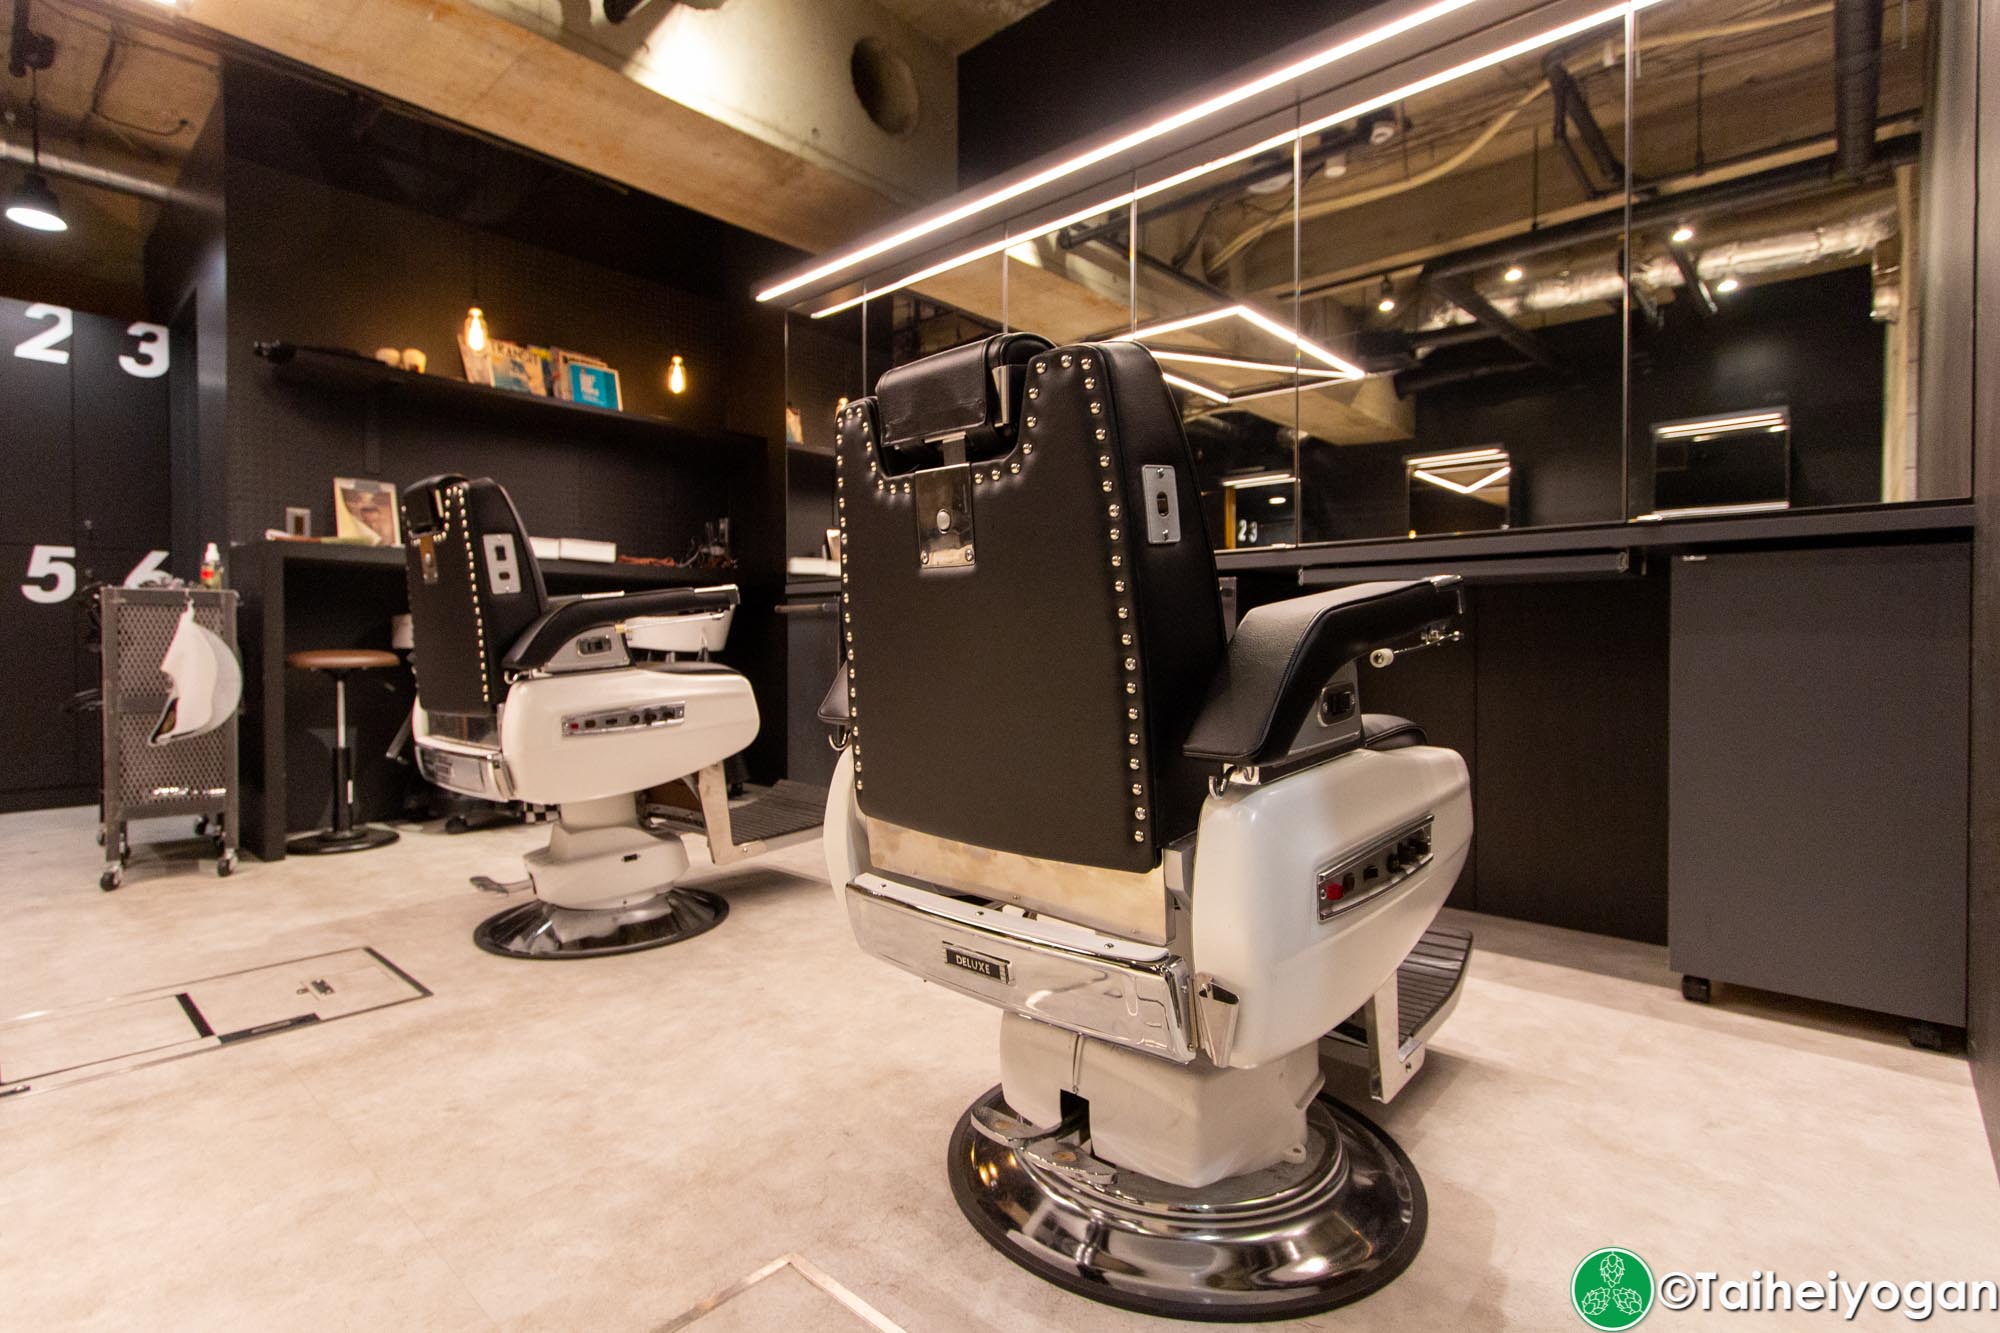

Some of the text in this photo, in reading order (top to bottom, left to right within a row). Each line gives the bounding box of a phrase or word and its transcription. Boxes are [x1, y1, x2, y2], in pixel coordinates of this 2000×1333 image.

[14, 303, 73, 364] 2
[119, 322, 170, 378] 3
[1237, 518, 1248, 542] 2
[22, 546, 76, 604] 5
[955, 954, 991, 975] DELUXE
